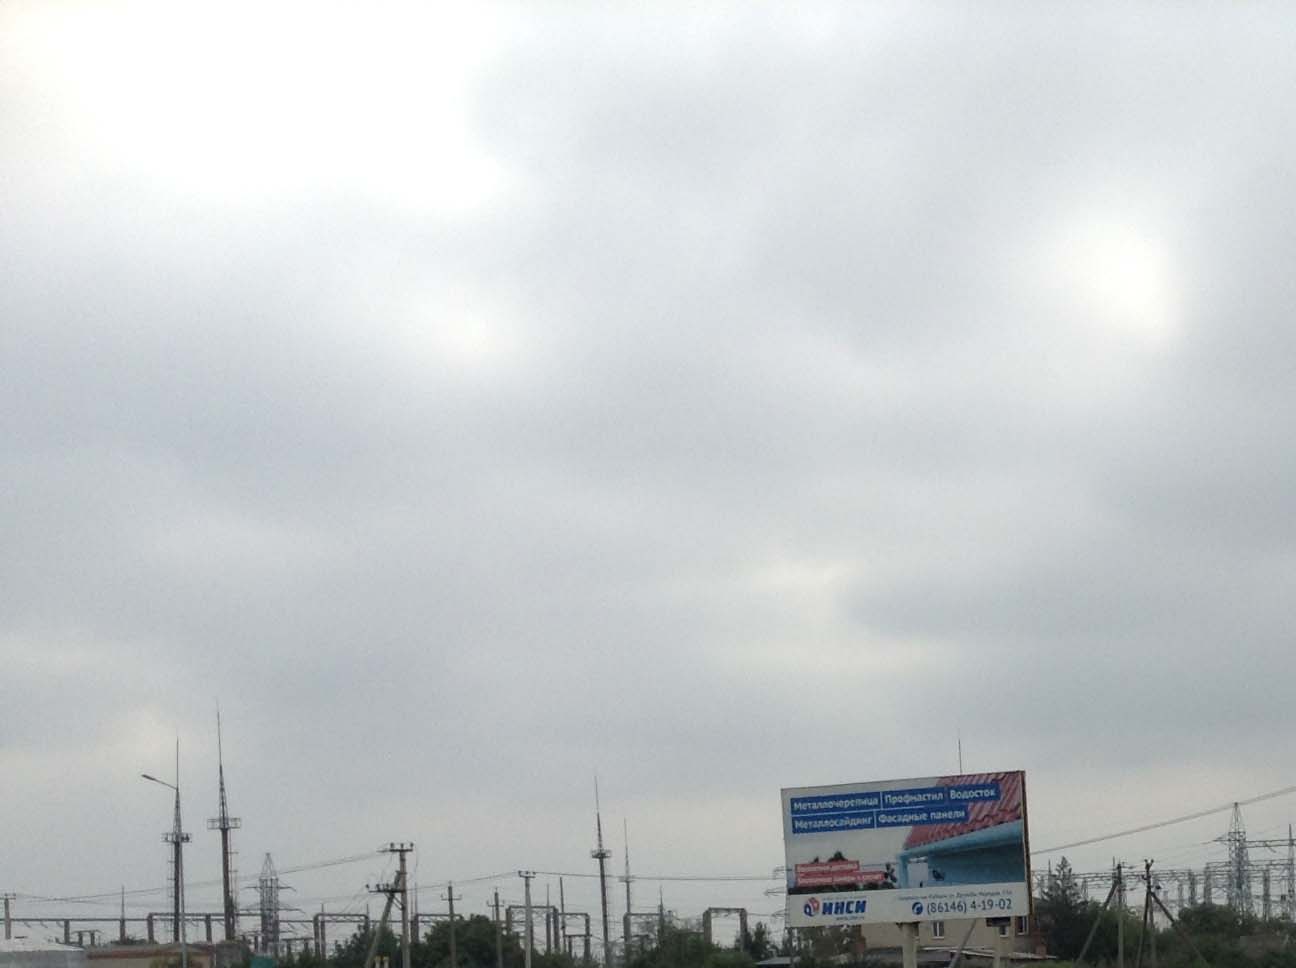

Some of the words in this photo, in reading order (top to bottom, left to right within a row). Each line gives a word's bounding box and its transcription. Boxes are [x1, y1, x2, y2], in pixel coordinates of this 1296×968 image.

[884, 792, 944, 806] Профнастил
[949, 788, 996, 800] Водосток
[930, 810, 966, 820] панели
[822, 900, 867, 915] ИНСИ
[927, 900, 967, 915] (86146)
[970, 898, 1013, 911] 4-19-02
